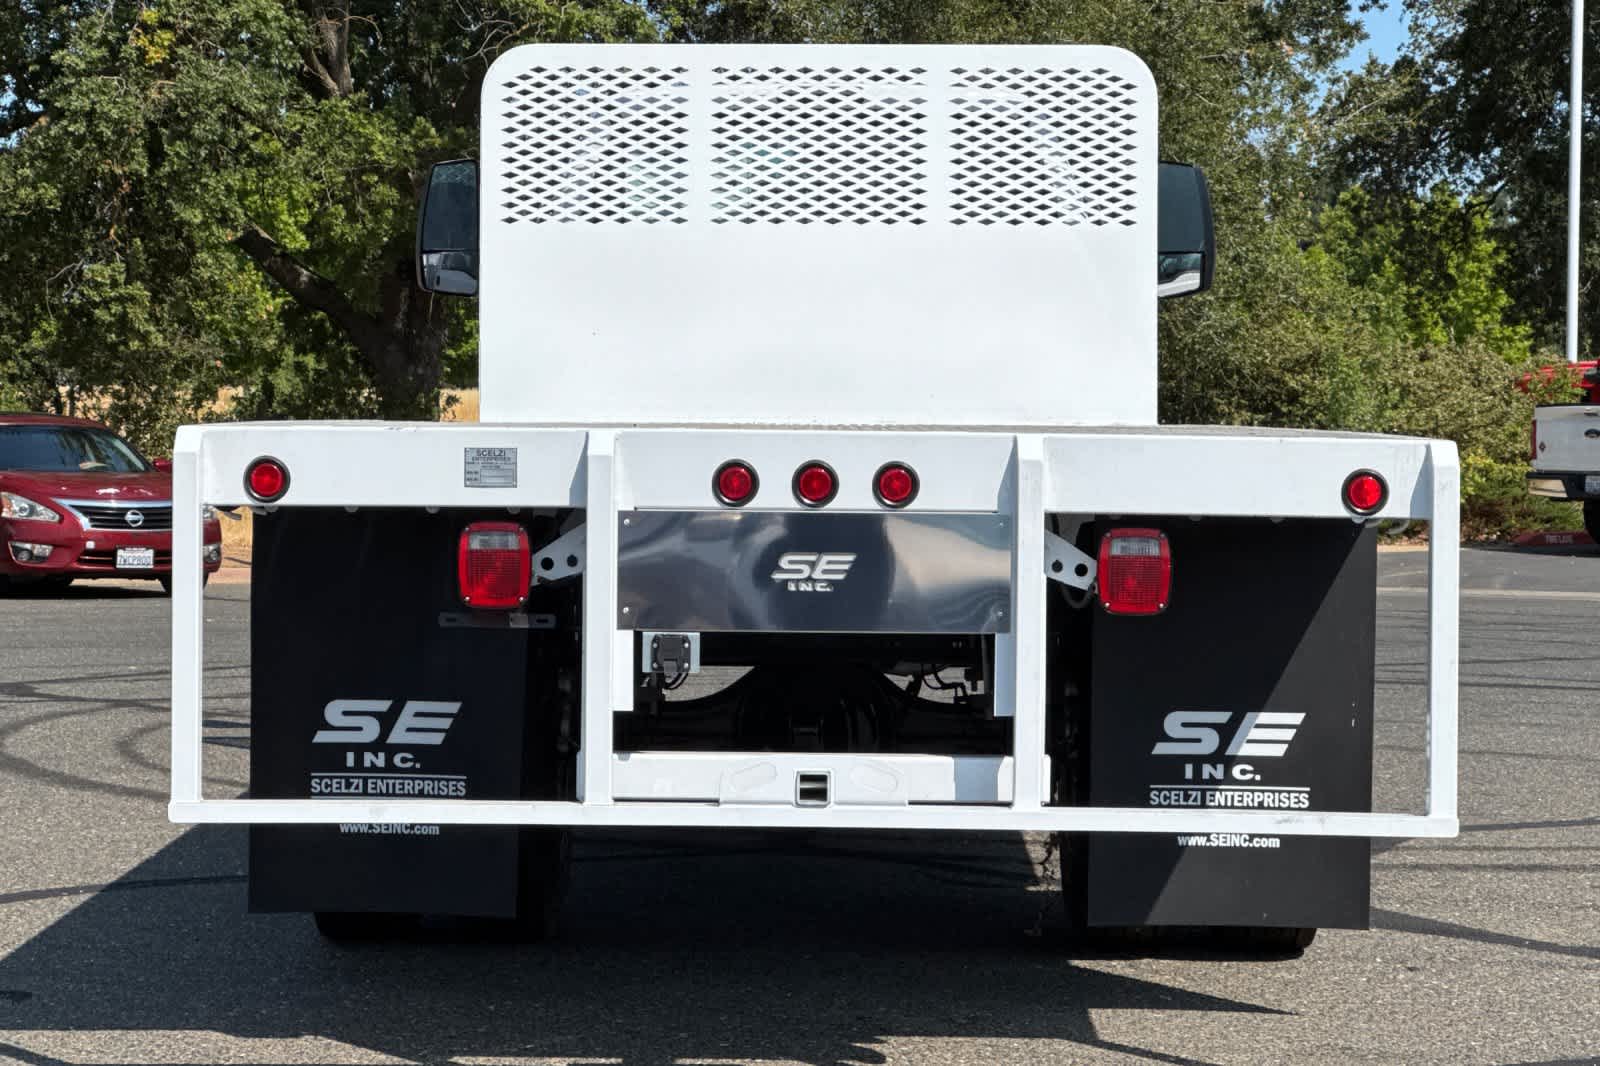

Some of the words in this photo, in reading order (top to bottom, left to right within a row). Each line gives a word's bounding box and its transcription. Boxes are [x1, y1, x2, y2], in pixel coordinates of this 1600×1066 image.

[476, 449, 506, 457] SCELZI
[771, 552, 857, 580] SE
[312, 699, 463, 745] SE
[1151, 710, 1307, 757] SE
[346, 751, 421, 769] INC.
[1184, 763, 1262, 781] INC.
[310, 778, 363, 793] SCELZI
[367, 778, 467, 797] ENTERPRISES
[1150, 790, 1202, 806] SCELZI
[1206, 790, 1310, 809] ENTERPRISES
[339, 822, 441, 836] www.SEINC.com
[1177, 833, 1281, 848] www.SEINC.com
